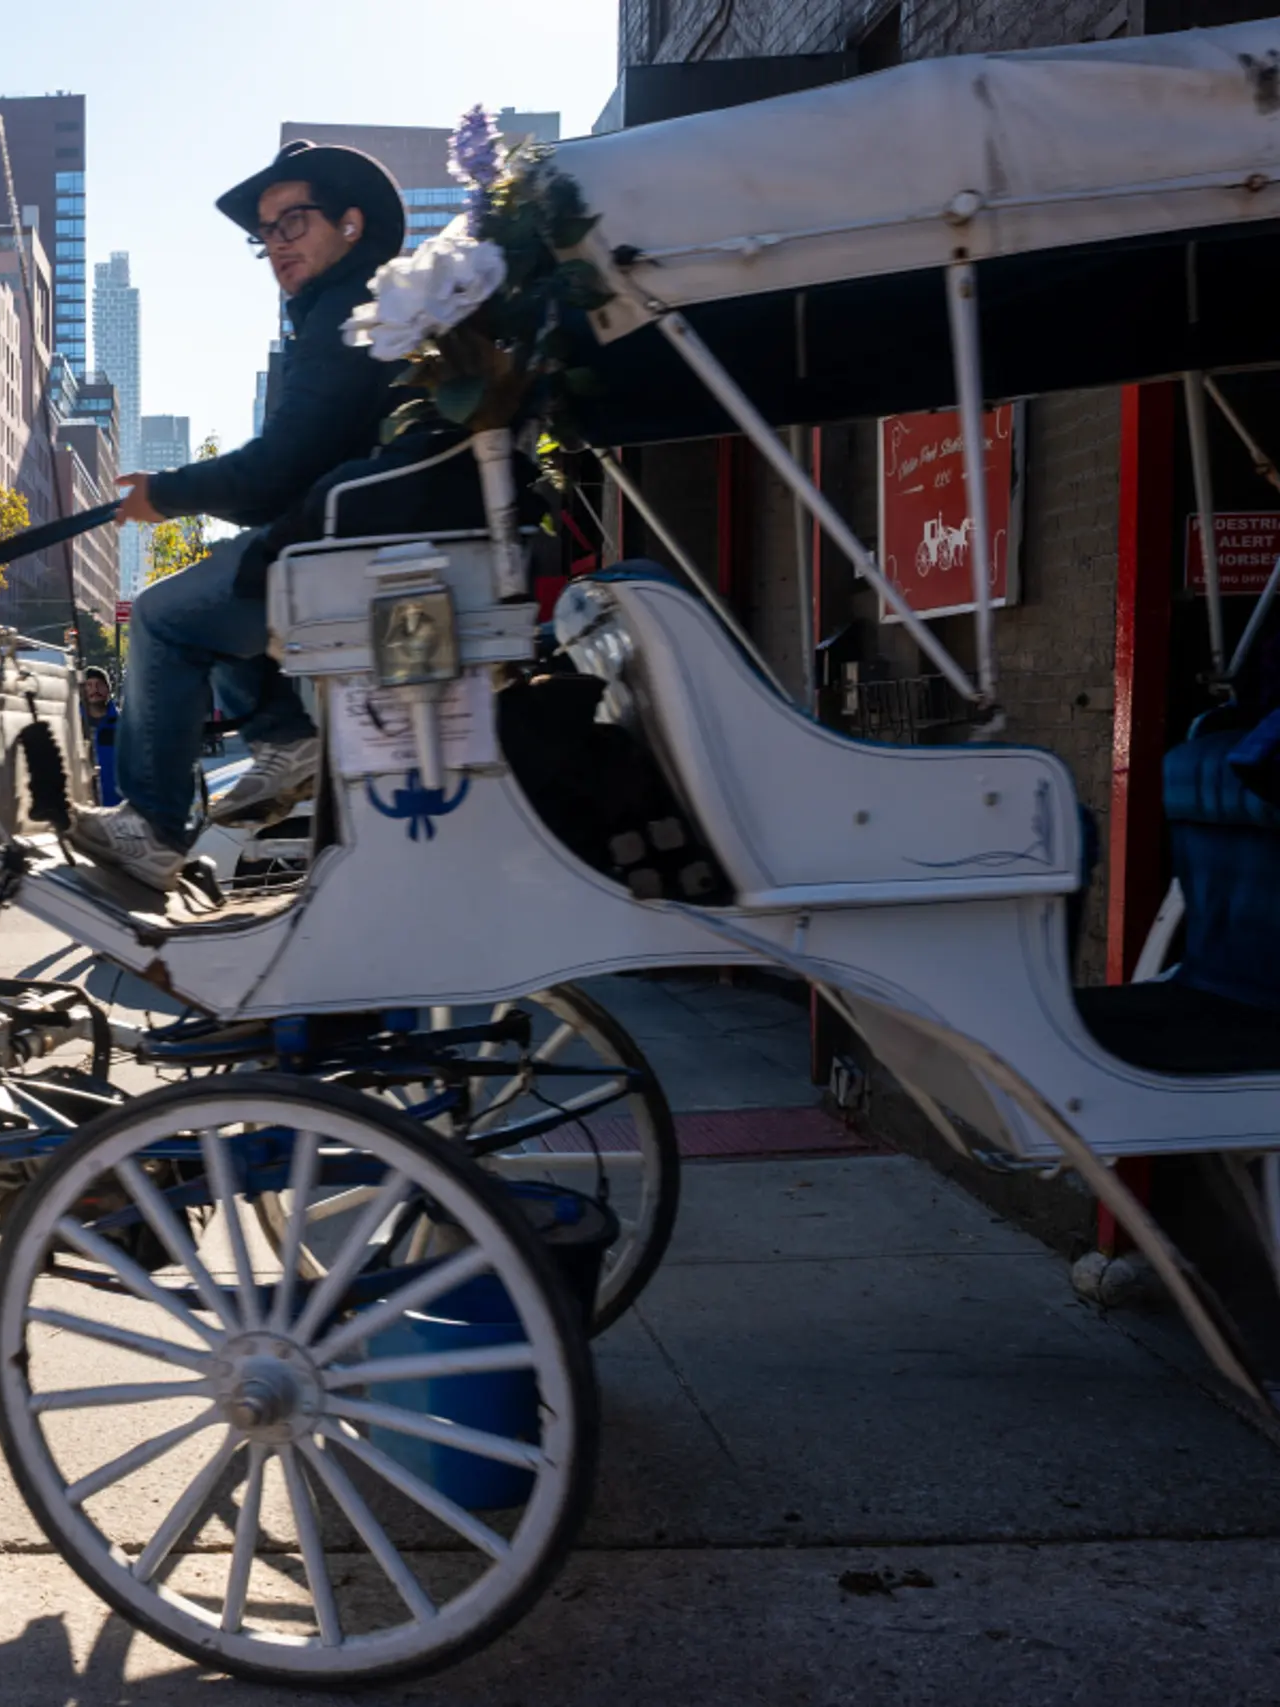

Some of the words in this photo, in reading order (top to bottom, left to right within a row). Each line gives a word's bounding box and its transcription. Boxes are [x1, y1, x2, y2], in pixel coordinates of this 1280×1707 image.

[1192, 518, 1280, 531] PDESTRI
[1218, 535, 1275, 548] ALERT
[1241, 574, 1270, 583] DRIV
